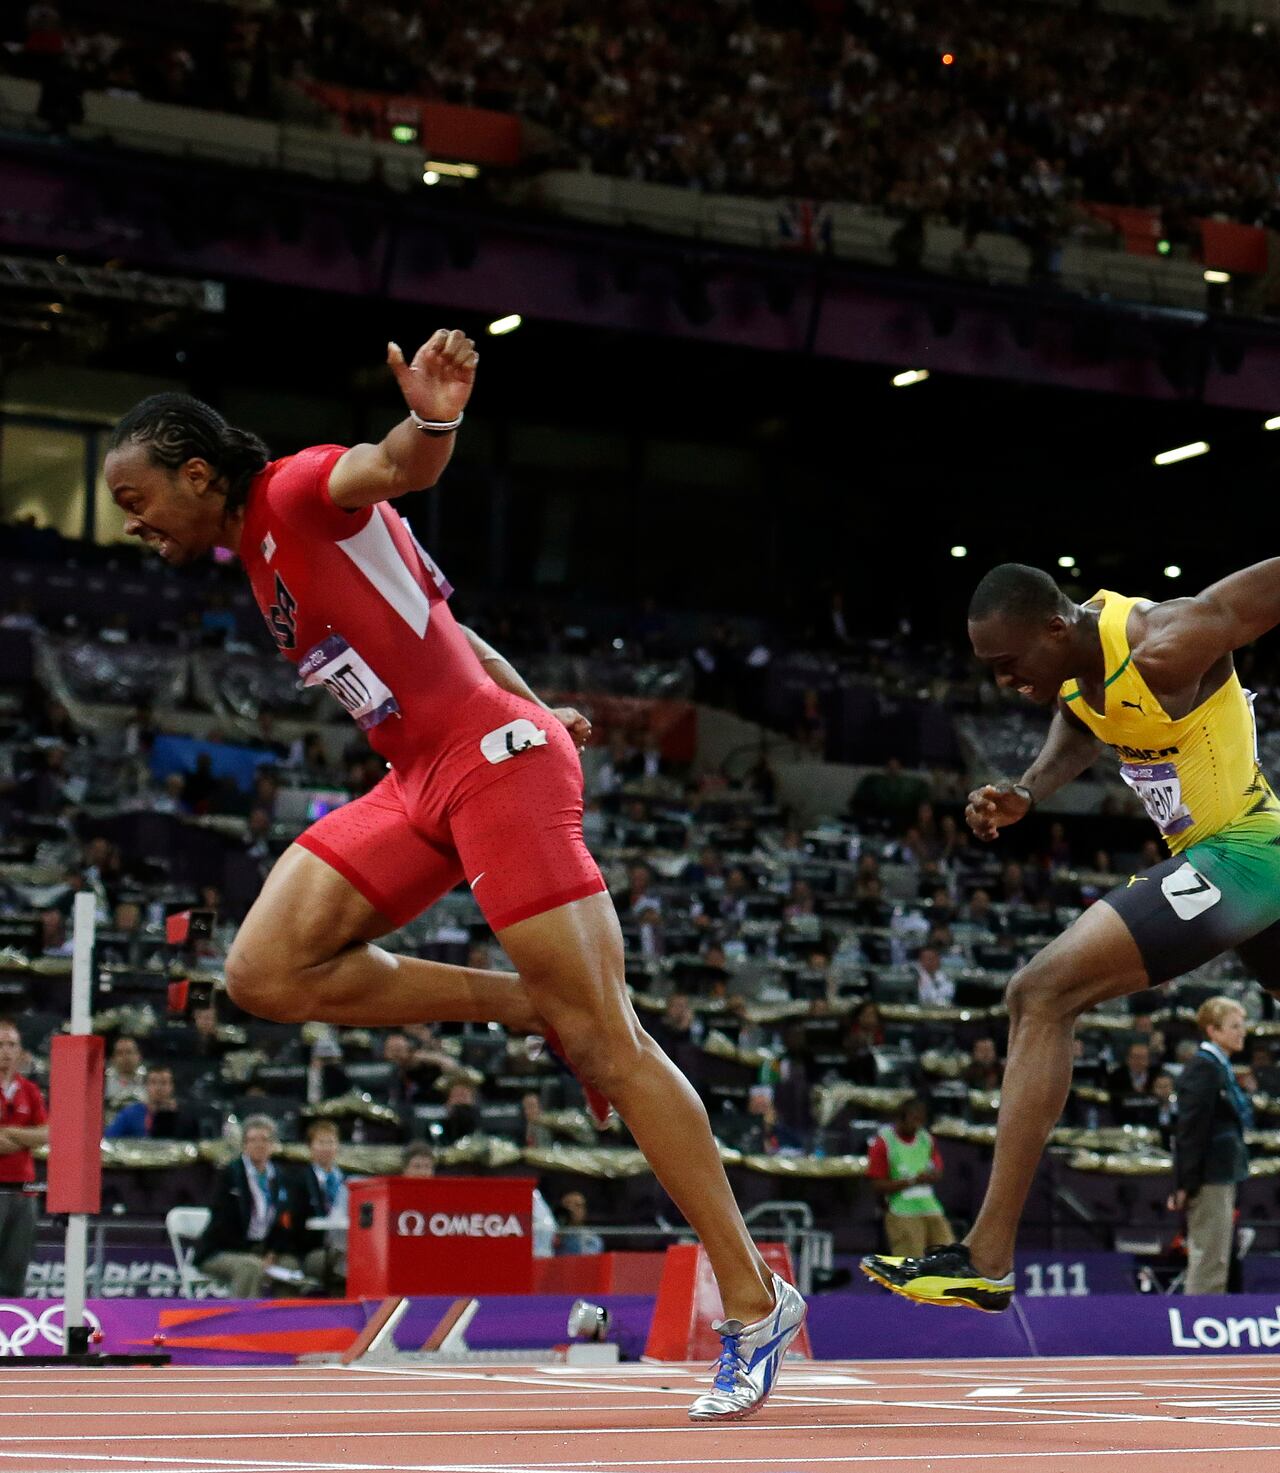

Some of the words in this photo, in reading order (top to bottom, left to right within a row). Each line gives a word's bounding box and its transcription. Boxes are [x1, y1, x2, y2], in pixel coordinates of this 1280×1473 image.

[1171, 873, 1211, 896] 7
[429, 1213, 524, 1237] OMEGA
[1024, 1263, 1090, 1297] 111
